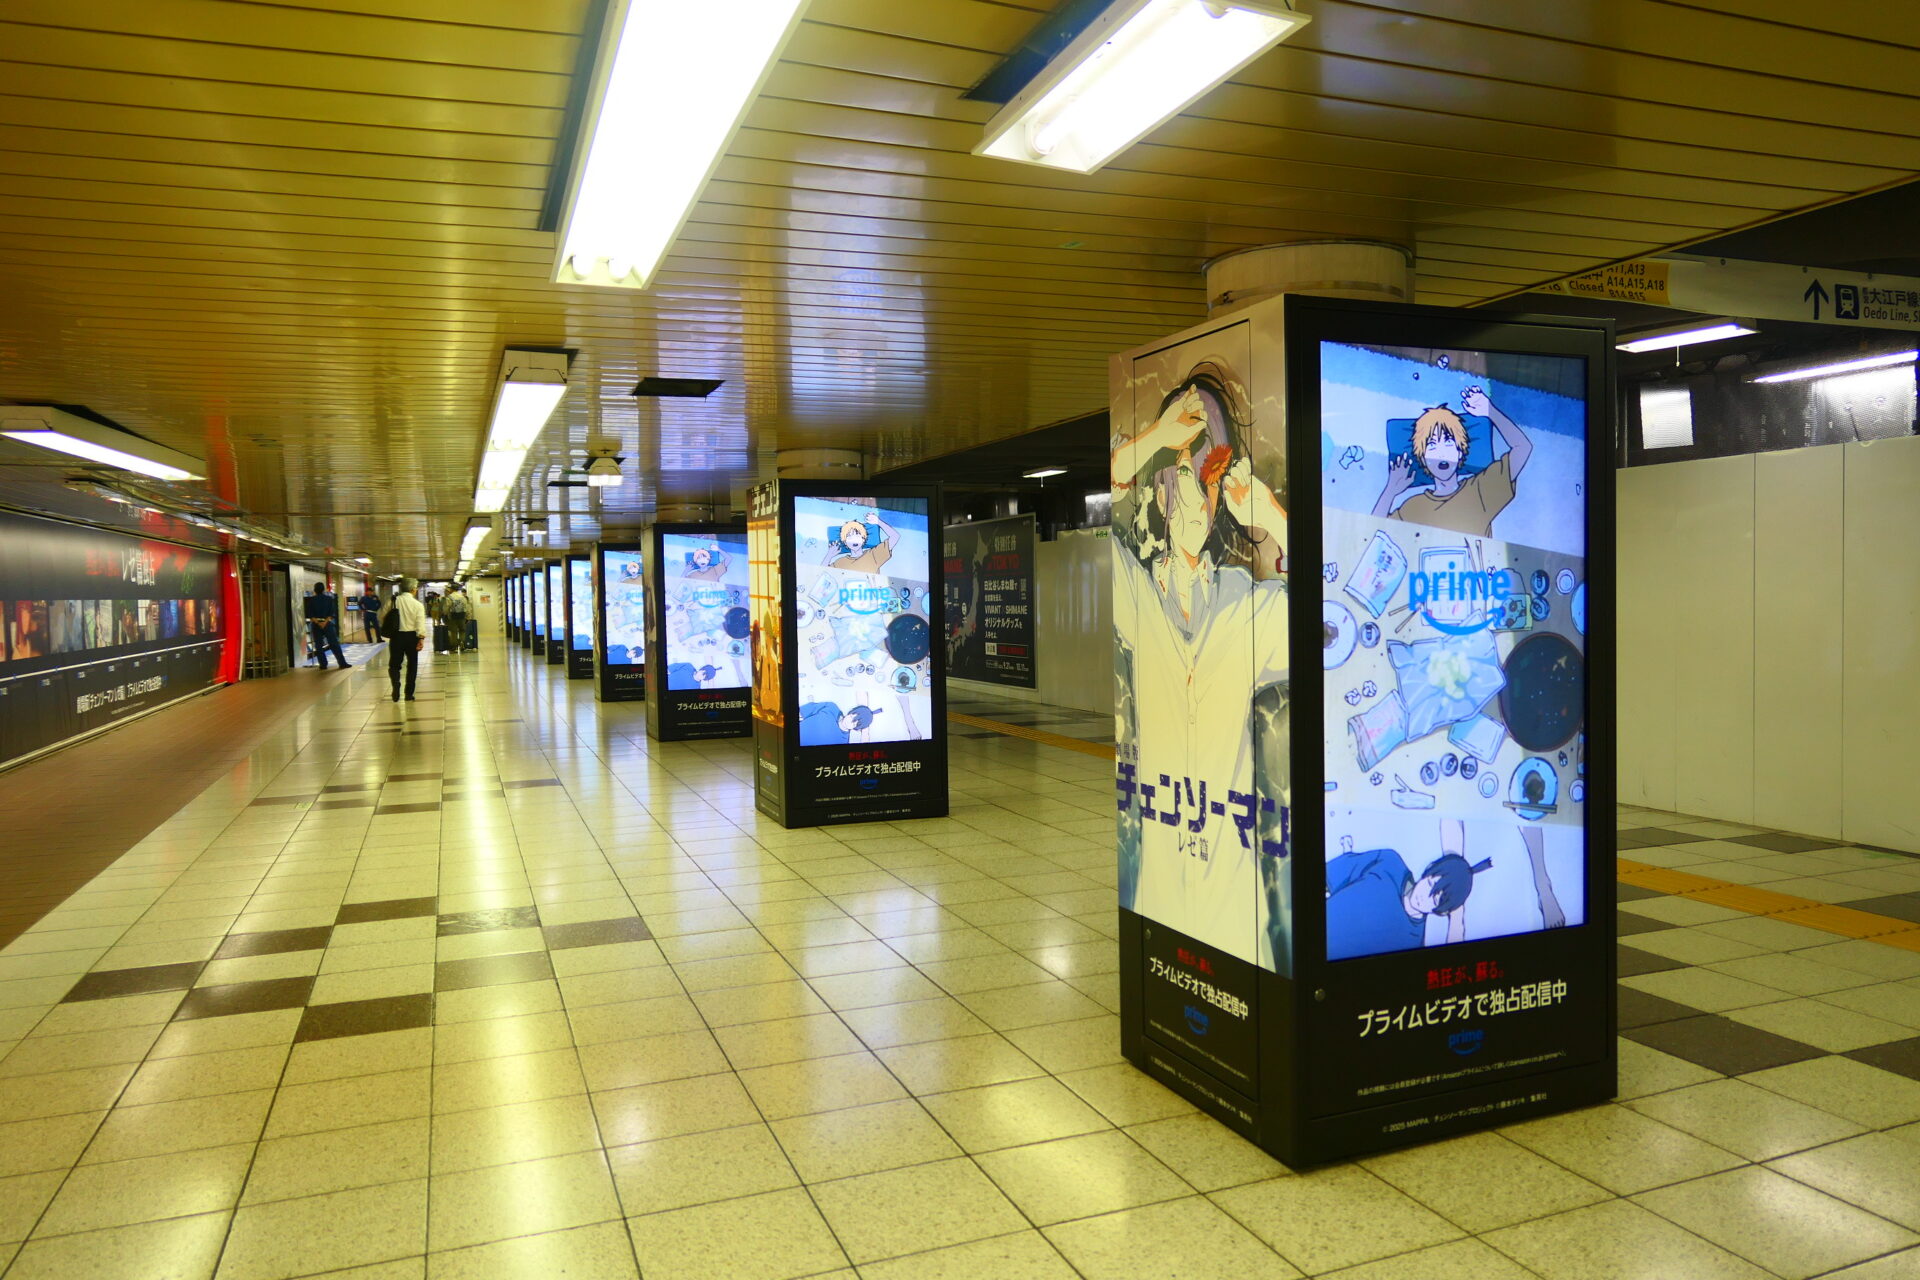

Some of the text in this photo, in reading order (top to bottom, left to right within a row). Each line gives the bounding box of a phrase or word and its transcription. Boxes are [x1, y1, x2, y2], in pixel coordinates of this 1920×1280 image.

[1568, 280, 1605, 293] Closed
[1606, 275, 1665, 291] A14,A15,A18
[1863, 305, 1888, 319] Oedo
[1890, 308, 1912, 324] Line,
[838, 584, 891, 603] prime
[1408, 561, 1512, 611] prime
[815, 760, 921, 778] プライムビデオで独占配信中
[1116, 761, 1290, 859] チェンソーマン
[1149, 956, 1249, 1021] プライムビデオで独占配信中
[1357, 978, 1567, 1038] プライムビデオで独占配信中
